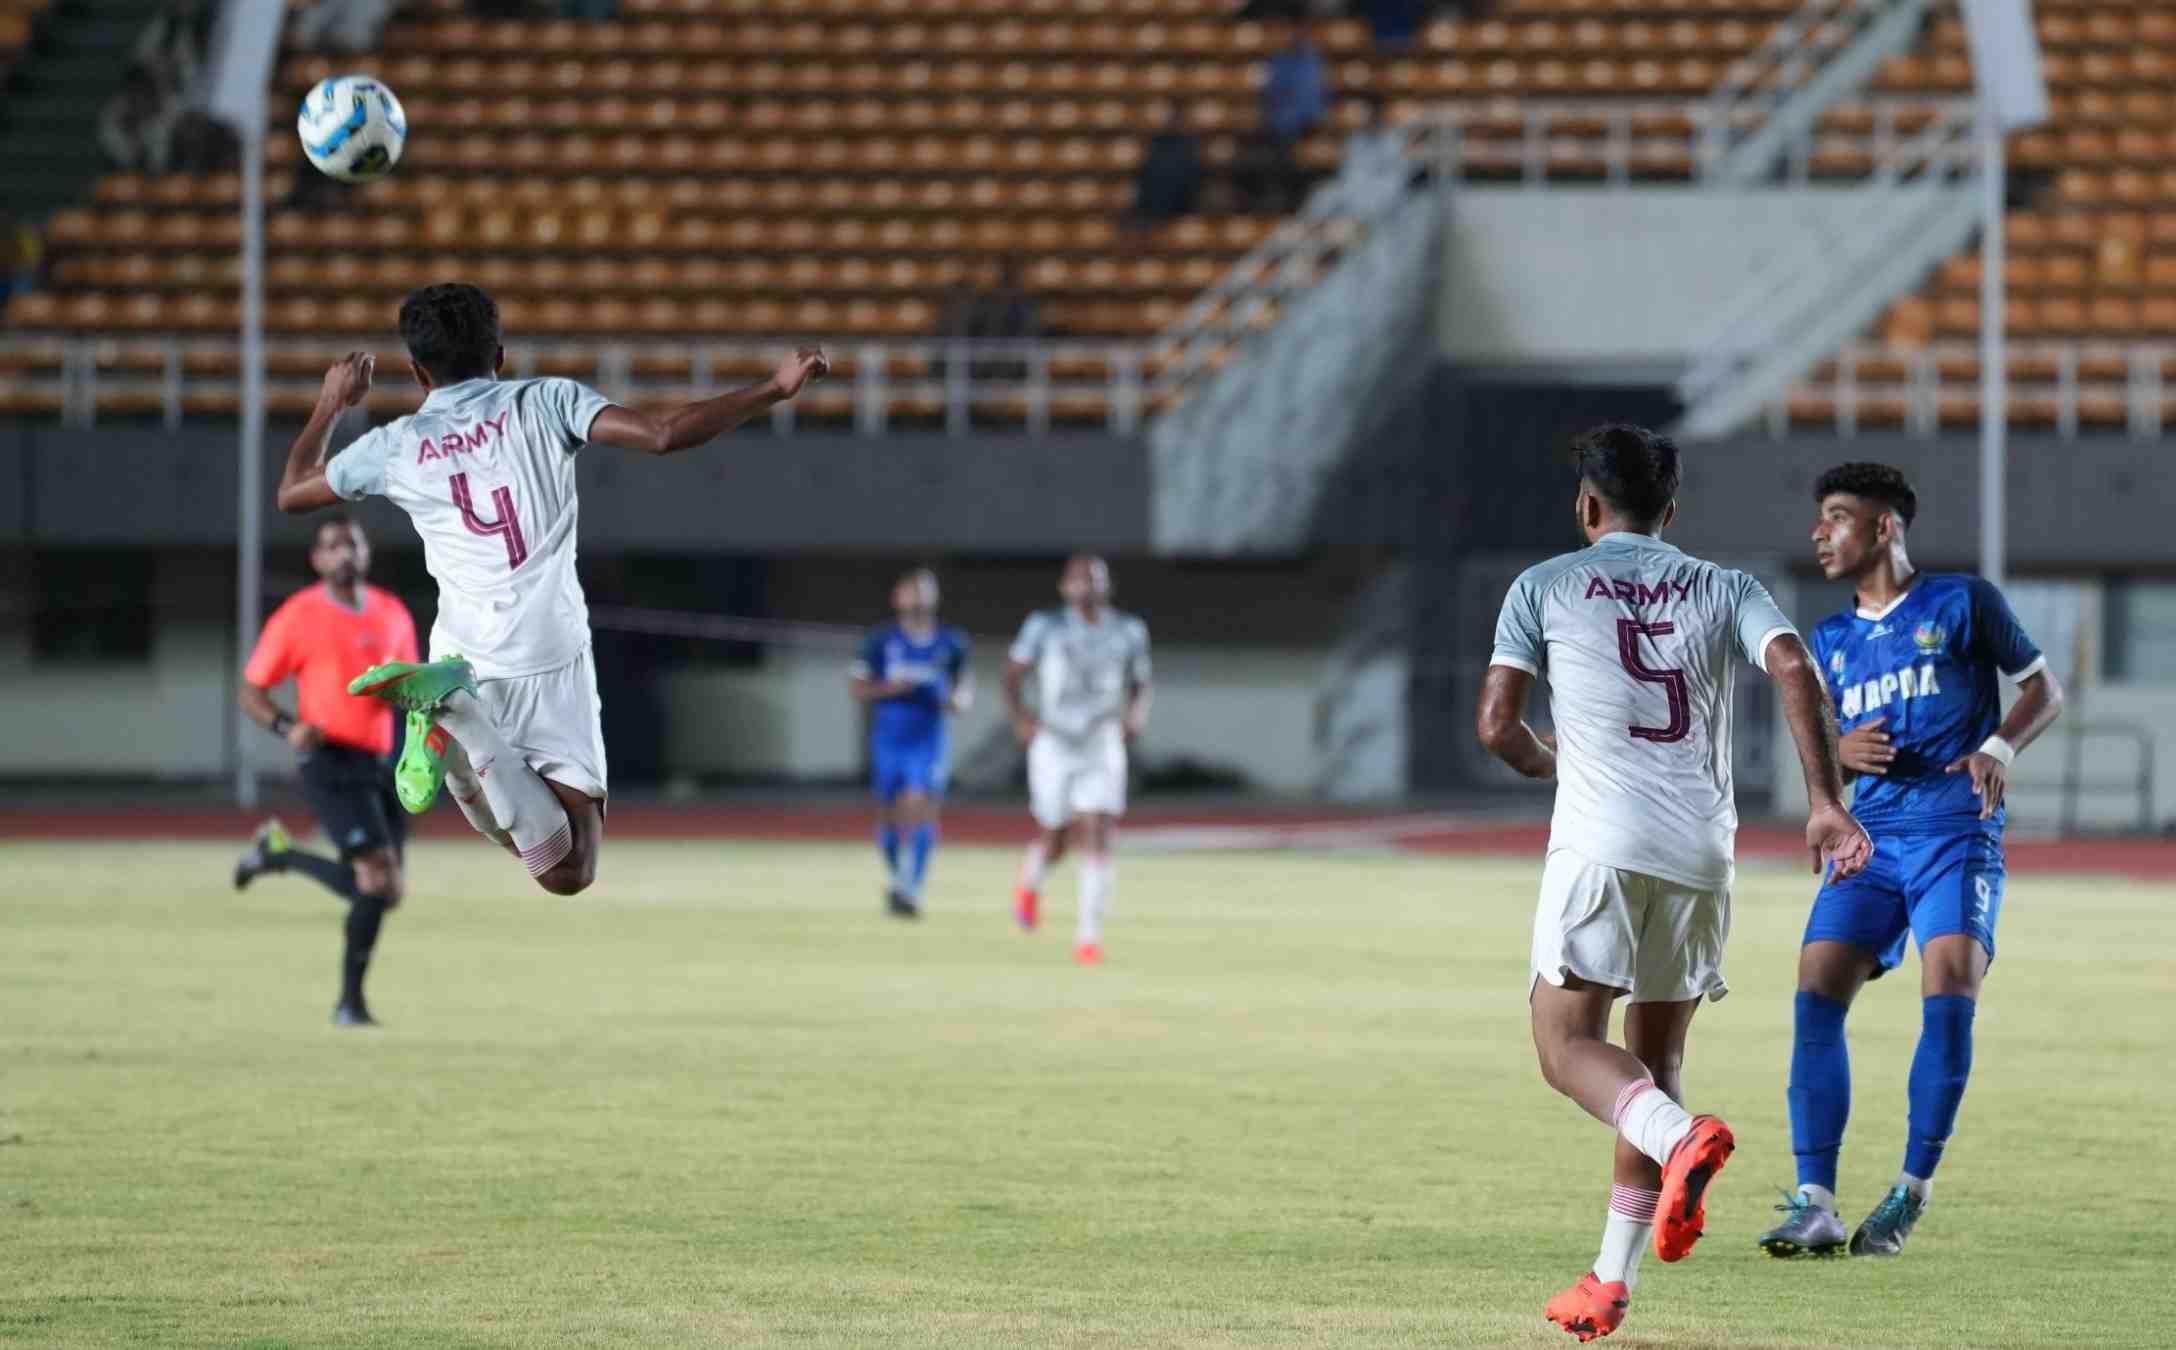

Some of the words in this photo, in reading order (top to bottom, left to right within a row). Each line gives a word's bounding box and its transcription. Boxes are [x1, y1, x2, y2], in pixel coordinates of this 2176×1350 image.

[417, 410, 507, 464] ARMY
[449, 472, 528, 570] 4
[1585, 576, 1693, 606] ARMY
[1616, 618, 1690, 743] 5
[1975, 875, 1991, 912] 9
